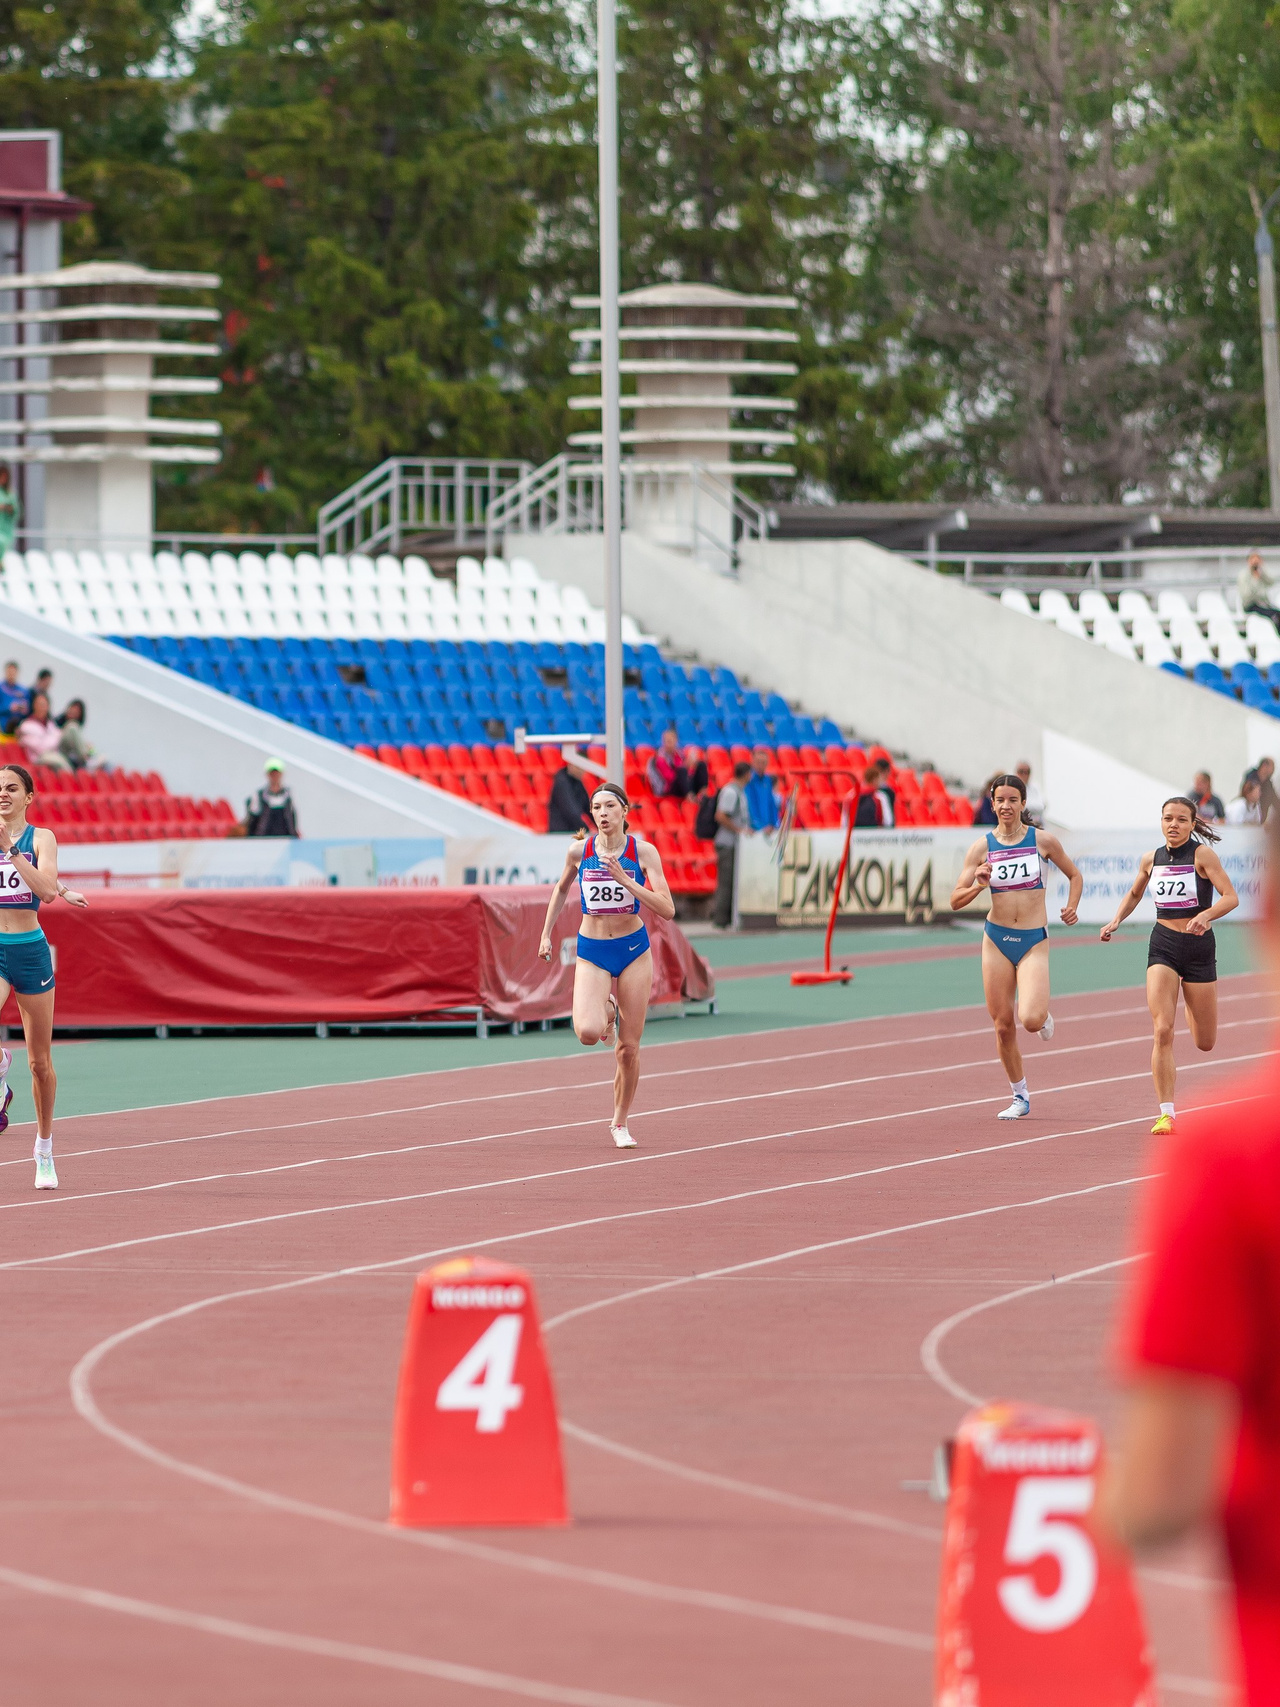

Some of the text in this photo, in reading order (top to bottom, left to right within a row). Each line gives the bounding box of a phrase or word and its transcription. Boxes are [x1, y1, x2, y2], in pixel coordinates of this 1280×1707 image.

[998, 862, 1031, 881] 371
[589, 886, 625, 902] 285
[1156, 880, 1187, 897] 372
[435, 1313, 524, 1434] 4
[996, 1474, 1099, 1634] 5
